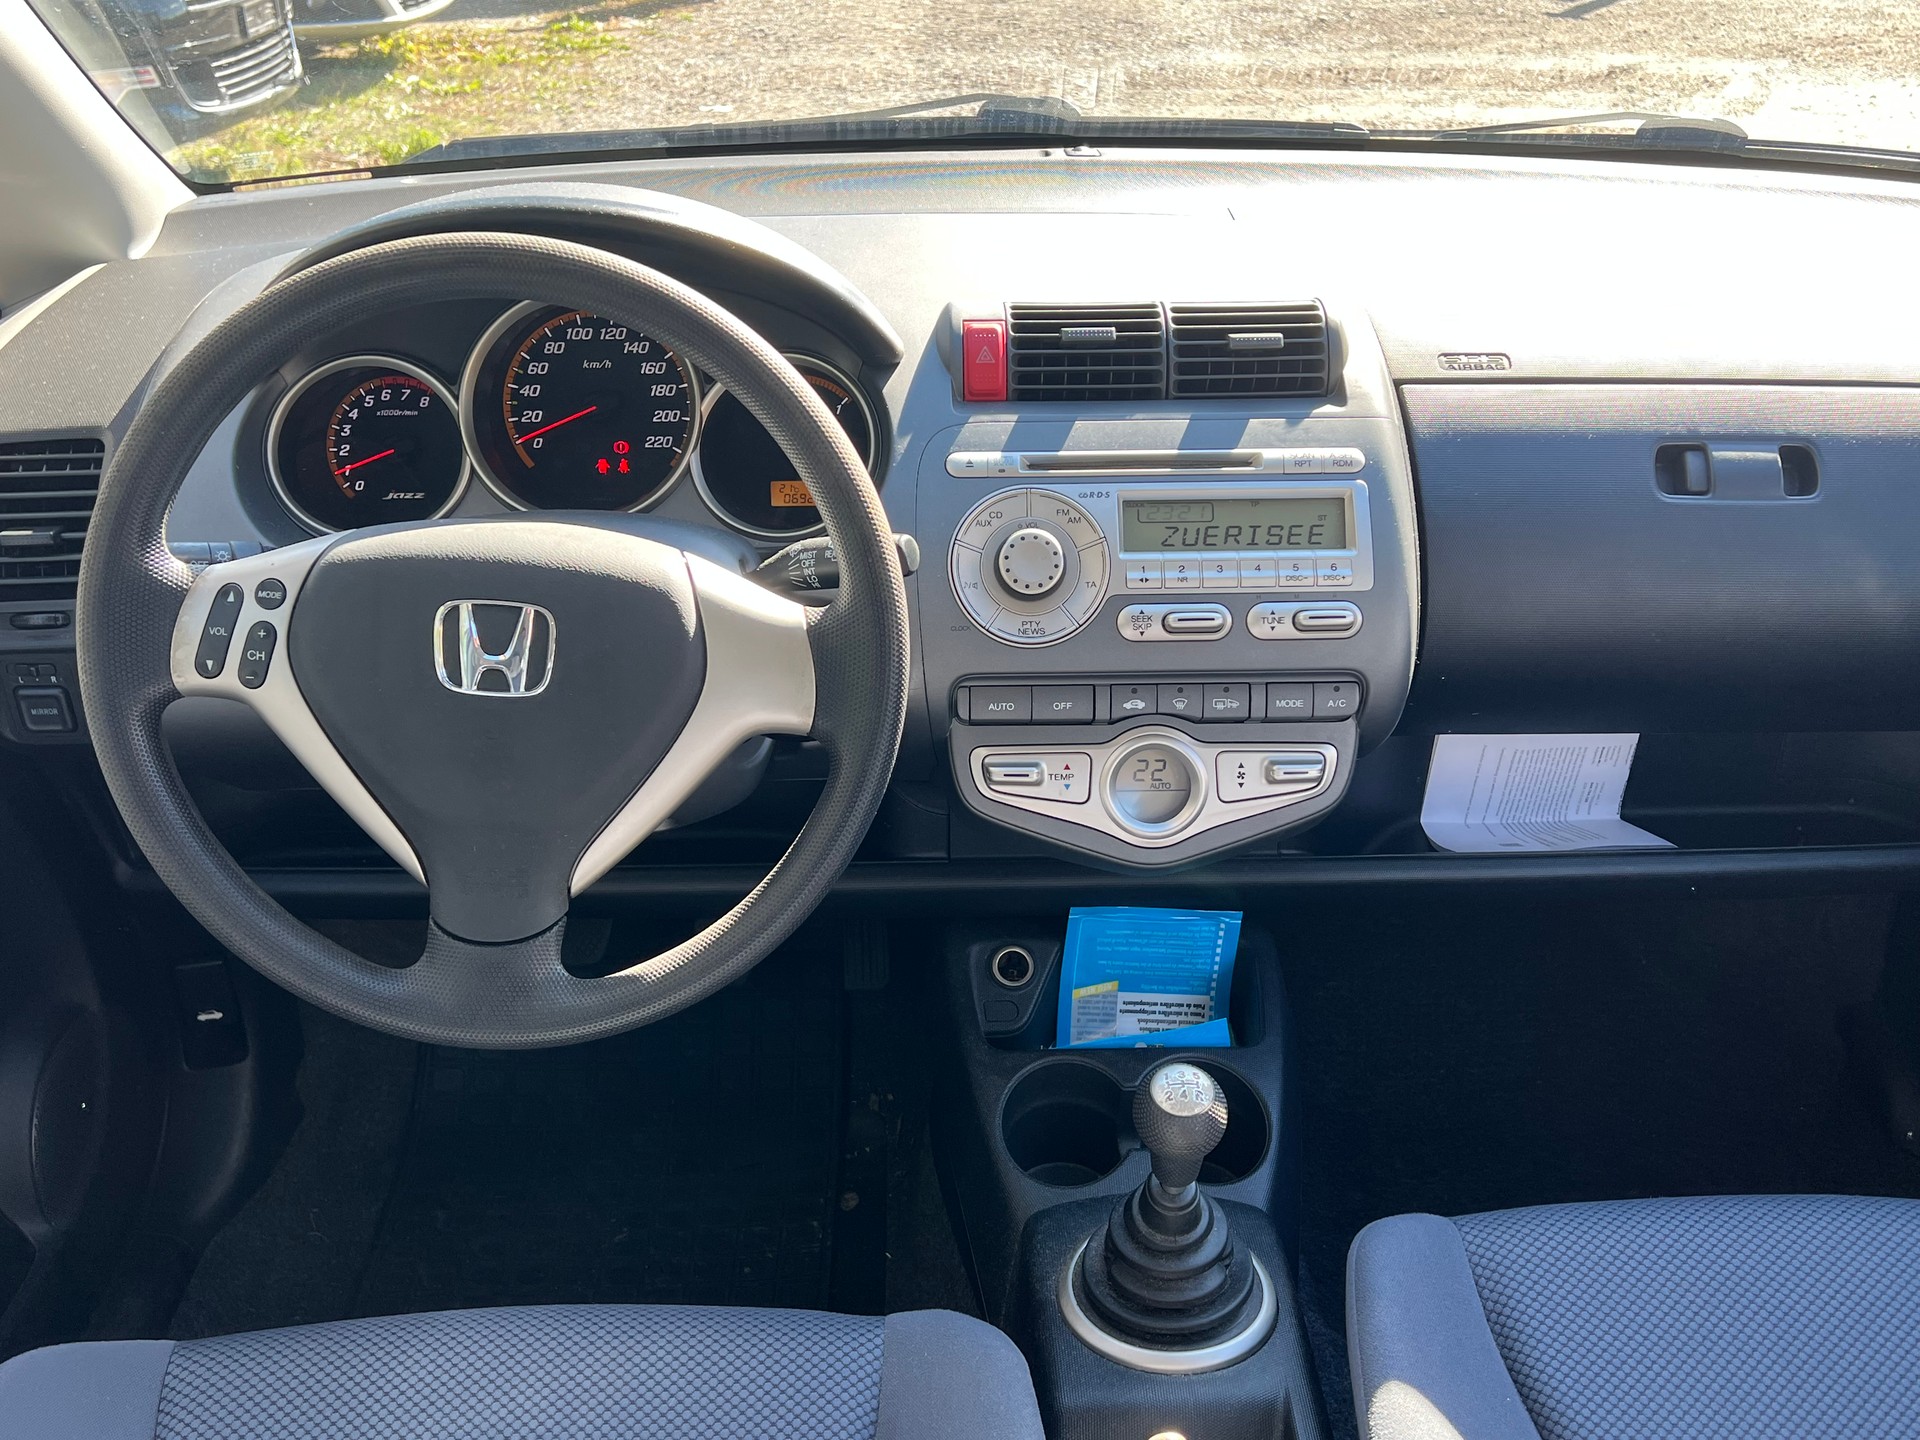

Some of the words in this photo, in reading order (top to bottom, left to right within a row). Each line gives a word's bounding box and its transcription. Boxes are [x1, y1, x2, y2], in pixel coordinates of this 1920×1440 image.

[566, 327, 593, 340] 100
[600, 327, 627, 340] 120
[543, 341, 565, 354] 80
[623, 341, 650, 354] 140
[527, 362, 549, 375] 60
[582, 359, 612, 369] km/h
[640, 362, 667, 375] 160
[381, 389, 392, 401] 6
[401, 389, 411, 401] 7
[519, 384, 541, 397] 40
[650, 384, 677, 397] 180
[364, 395, 375, 407] 5
[420, 396, 430, 408] 8
[348, 408, 359, 420] 4
[521, 410, 543, 423] 20
[652, 410, 680, 423] 200
[340, 424, 352, 437] 3
[533, 438, 543, 449] 0
[645, 436, 673, 448] 220
[339, 444, 350, 456] 2
[355, 480, 365, 491] 0
[989, 511, 1003, 519] CD
[1067, 516, 1082, 524] AM
[1160, 525, 1325, 548] ZUERISEE
[800, 551, 817, 560] MIST
[801, 559, 815, 567] OFF
[1254, 564, 1262, 572] 4
[1292, 563, 1299, 572] 5
[1330, 563, 1338, 572] 6
[803, 567, 816, 576] INT
[1141, 565, 1146, 573] 1
[1178, 565, 1186, 573] 2
[1216, 564, 1224, 573] 3
[807, 575, 819, 583] LO
[258, 591, 282, 599] MODE
[1021, 620, 1041, 628] PTY
[1131, 615, 1153, 623] SEEK
[1262, 616, 1285, 625] TUNE
[209, 627, 228, 636] VOL
[1132, 623, 1152, 631] SKIP
[247, 650, 265, 661] CH
[988, 701, 1015, 711] AUTO
[1053, 701, 1073, 711] OFF
[1276, 699, 1304, 709] MODE
[1328, 698, 1346, 708] A/C
[1132, 758, 1167, 782] 22
[1048, 772, 1075, 782] TEMP
[1150, 782, 1172, 790] AUTO
